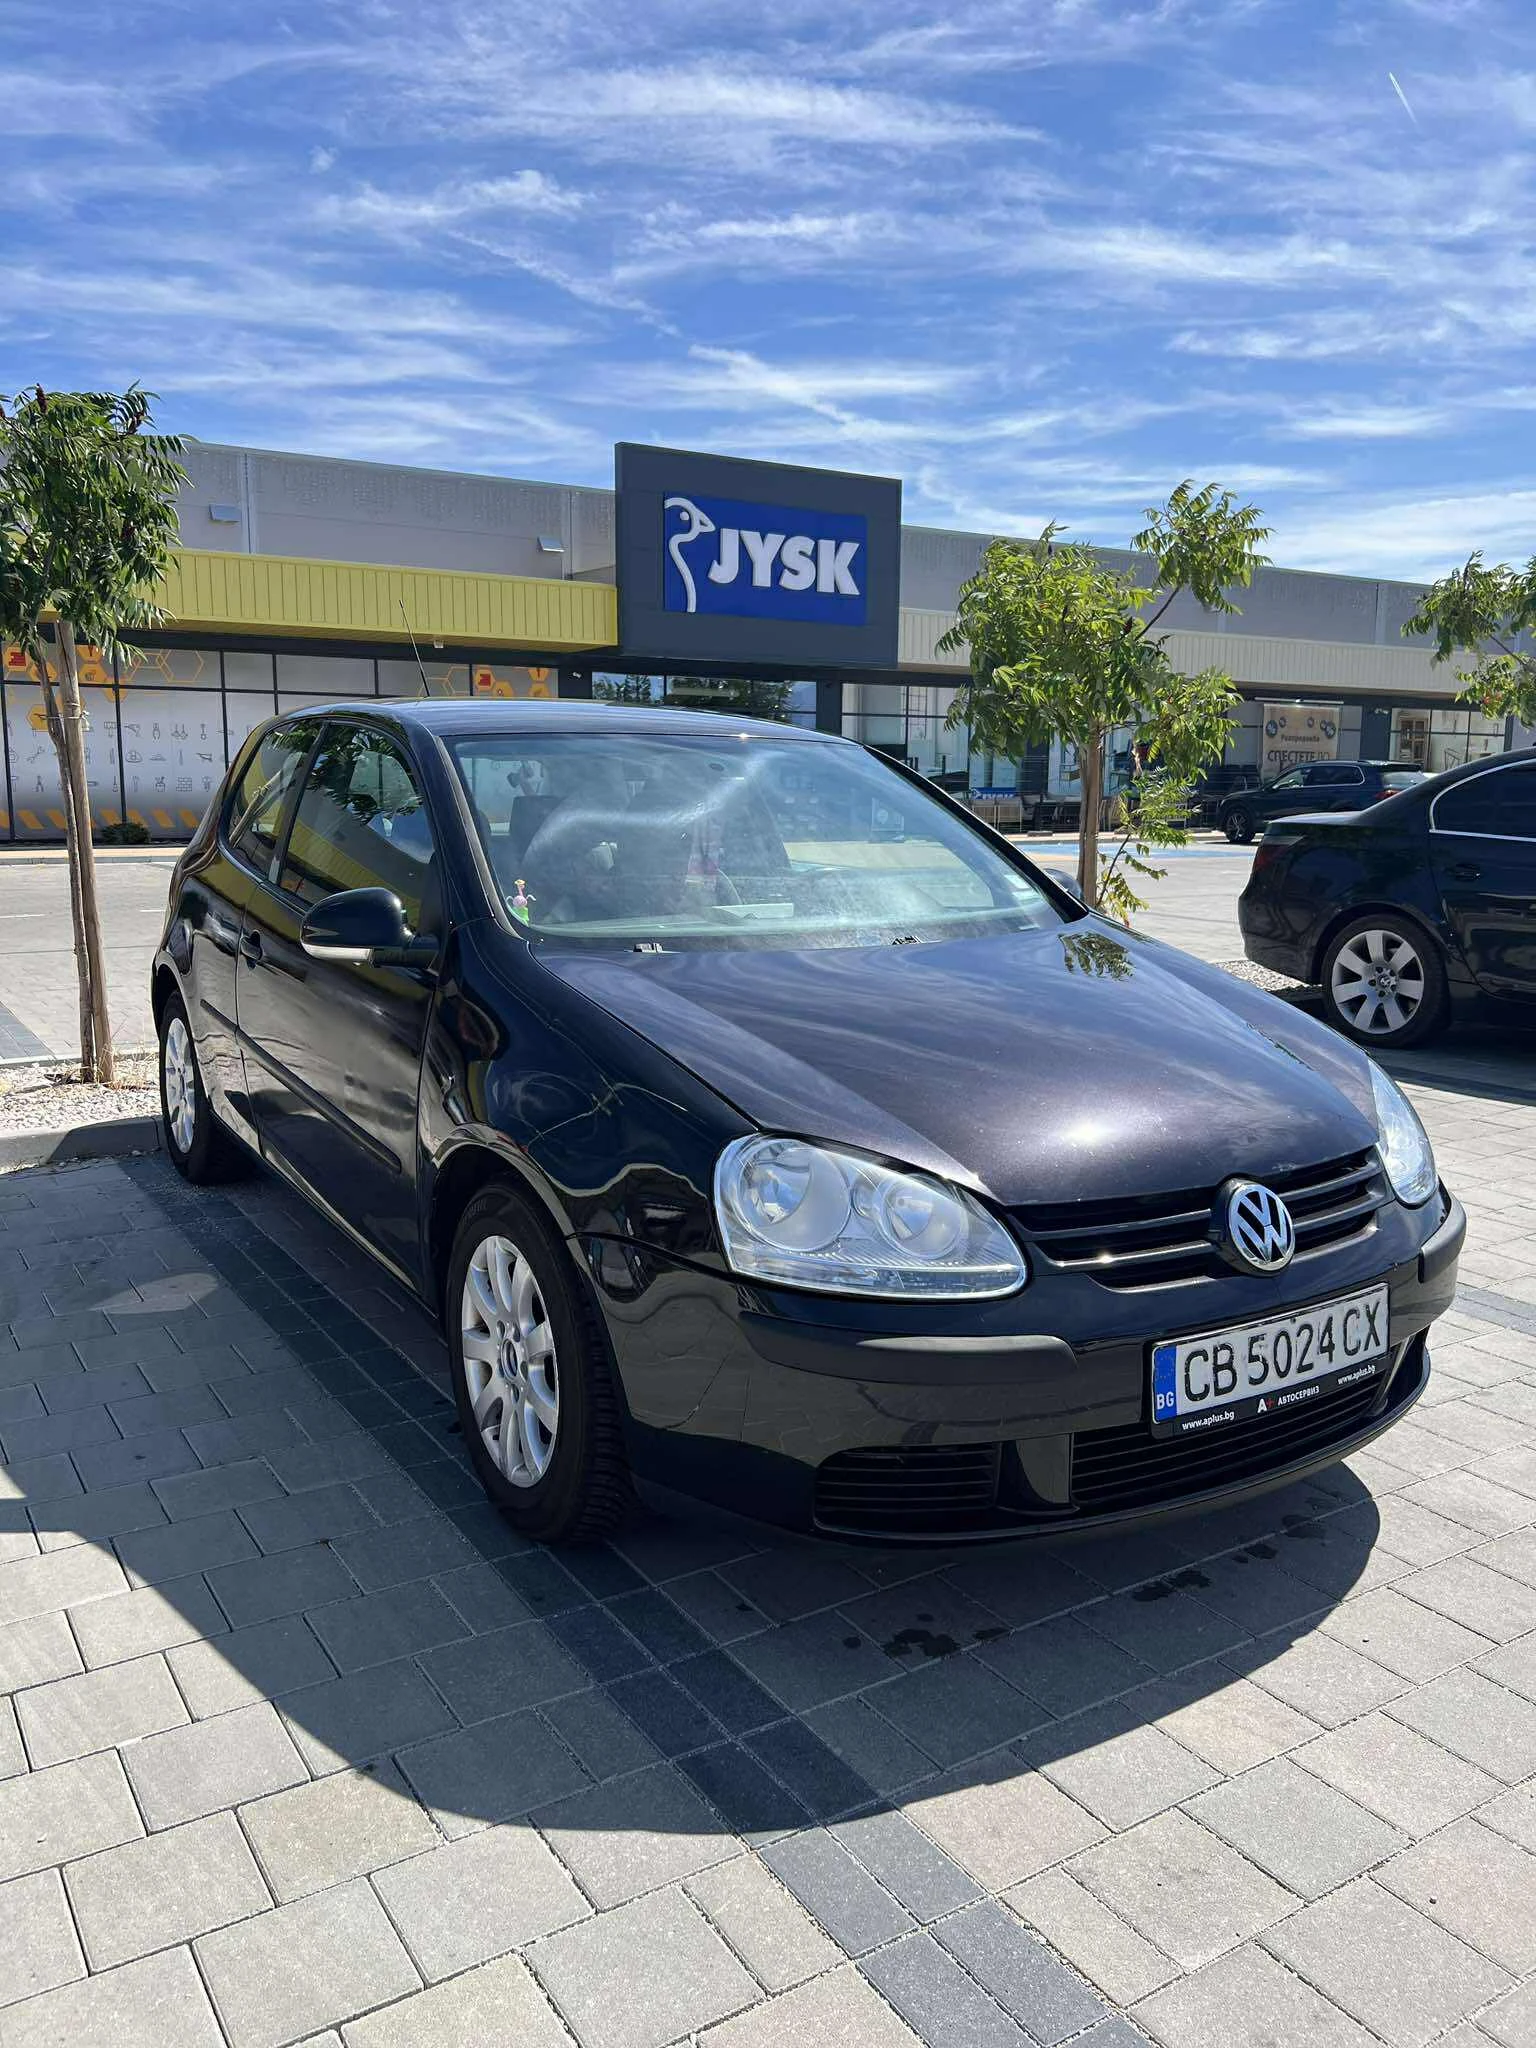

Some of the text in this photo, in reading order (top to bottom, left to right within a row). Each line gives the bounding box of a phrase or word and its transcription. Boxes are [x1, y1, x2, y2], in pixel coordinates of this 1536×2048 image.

[707, 527, 861, 596] JYSK
[1247, 1316, 1335, 1386] 5024
[1338, 1364, 1376, 1385] www.aplus.bg
[1156, 1391, 1175, 1410] BG
[1278, 1385, 1320, 1406] АВТОСЕРВИЗ
[1182, 1411, 1235, 1430] www.aplus.bg
